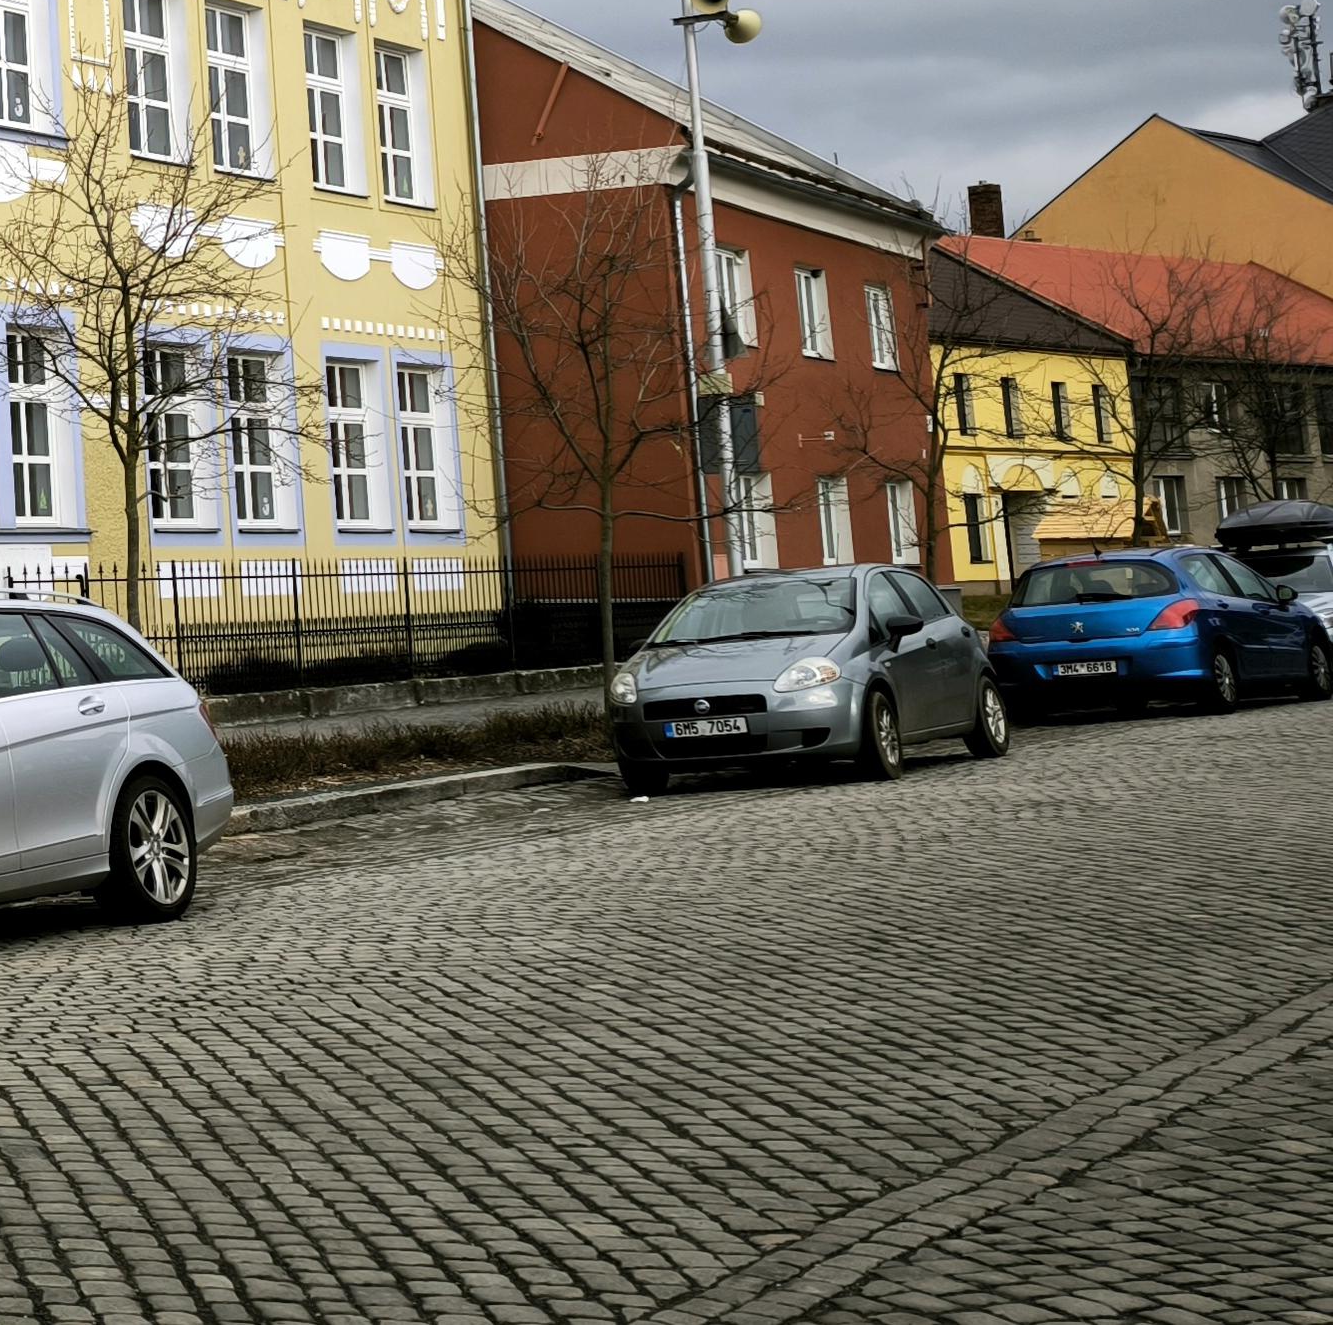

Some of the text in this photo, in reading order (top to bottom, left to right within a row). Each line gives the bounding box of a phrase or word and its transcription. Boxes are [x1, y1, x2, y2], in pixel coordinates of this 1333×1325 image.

[1060, 661, 1112, 674] 3M4 6618
[675, 719, 741, 736] 6M5 7054
